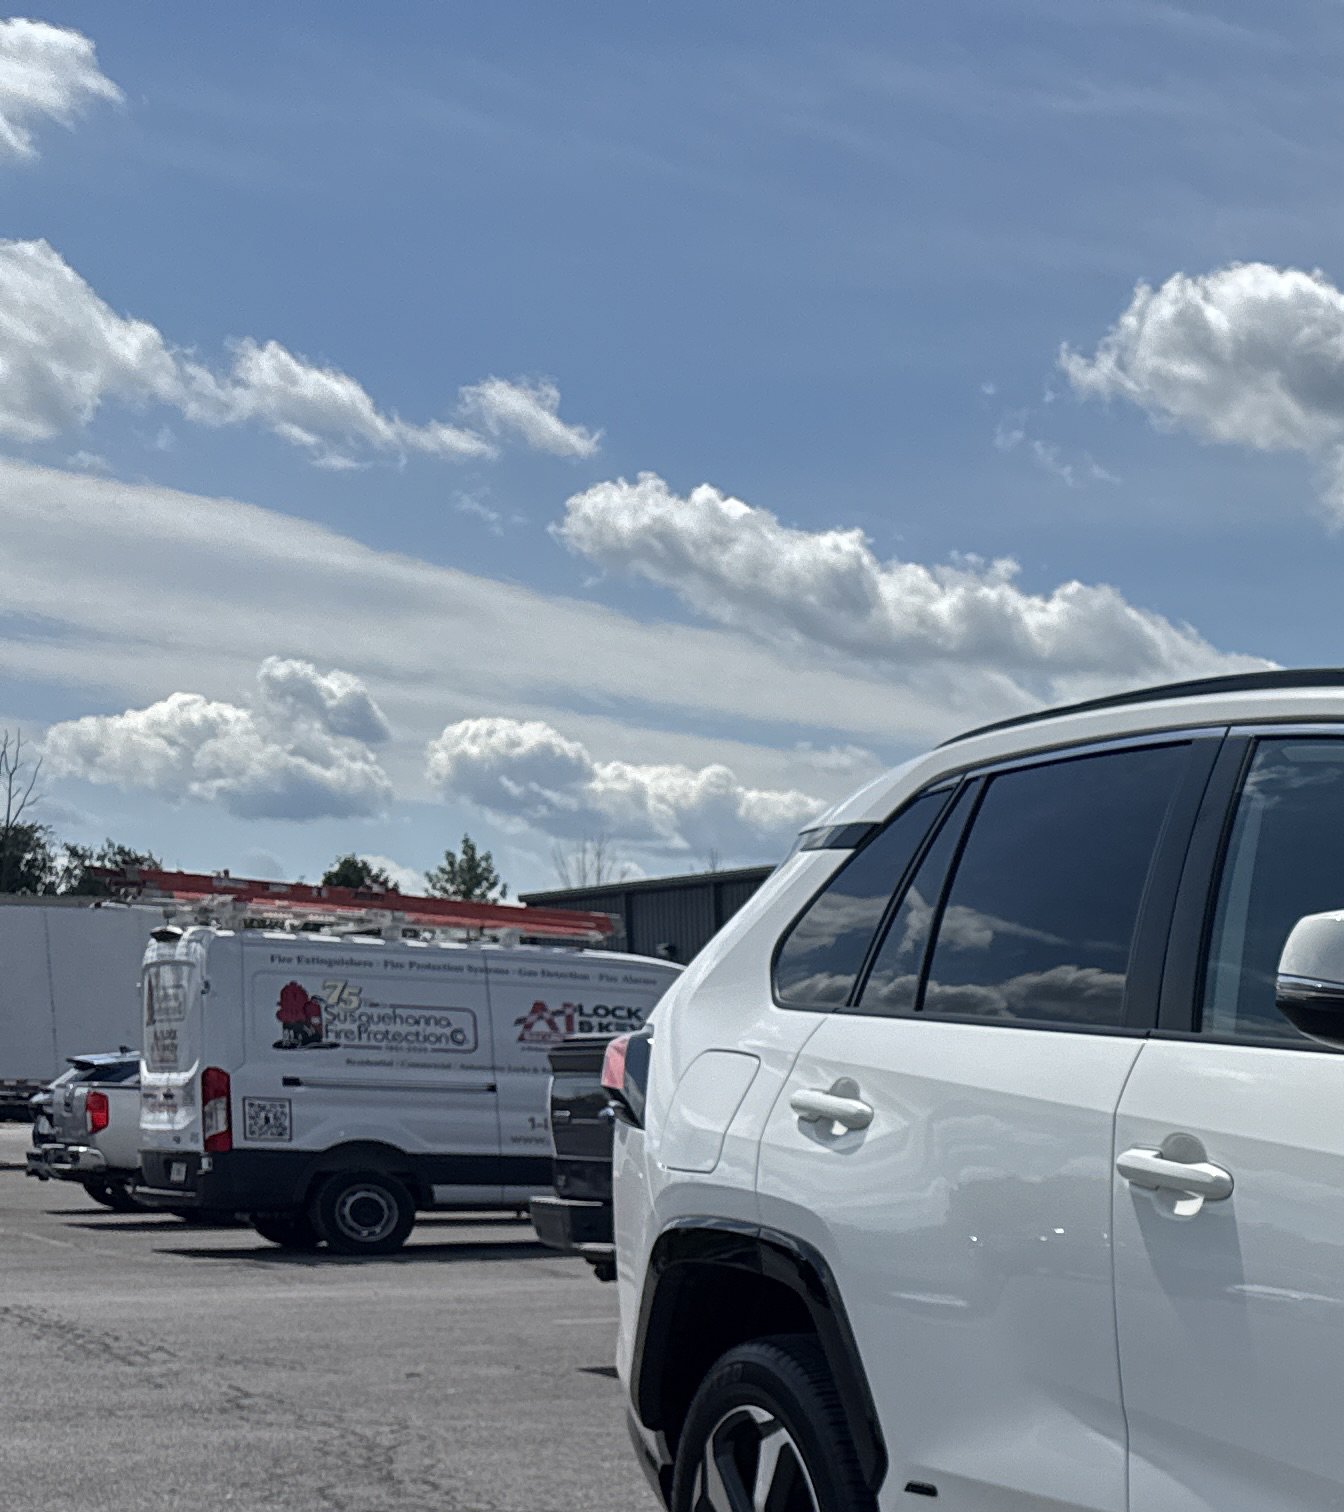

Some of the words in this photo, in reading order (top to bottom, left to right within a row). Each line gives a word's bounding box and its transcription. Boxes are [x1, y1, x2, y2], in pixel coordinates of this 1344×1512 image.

[270, 954, 293, 964] Fire
[408, 960, 465, 973] Protection
[322, 979, 363, 1012] 75
[323, 1005, 452, 1029] Susquehanna
[578, 1003, 643, 1021] LOCK
